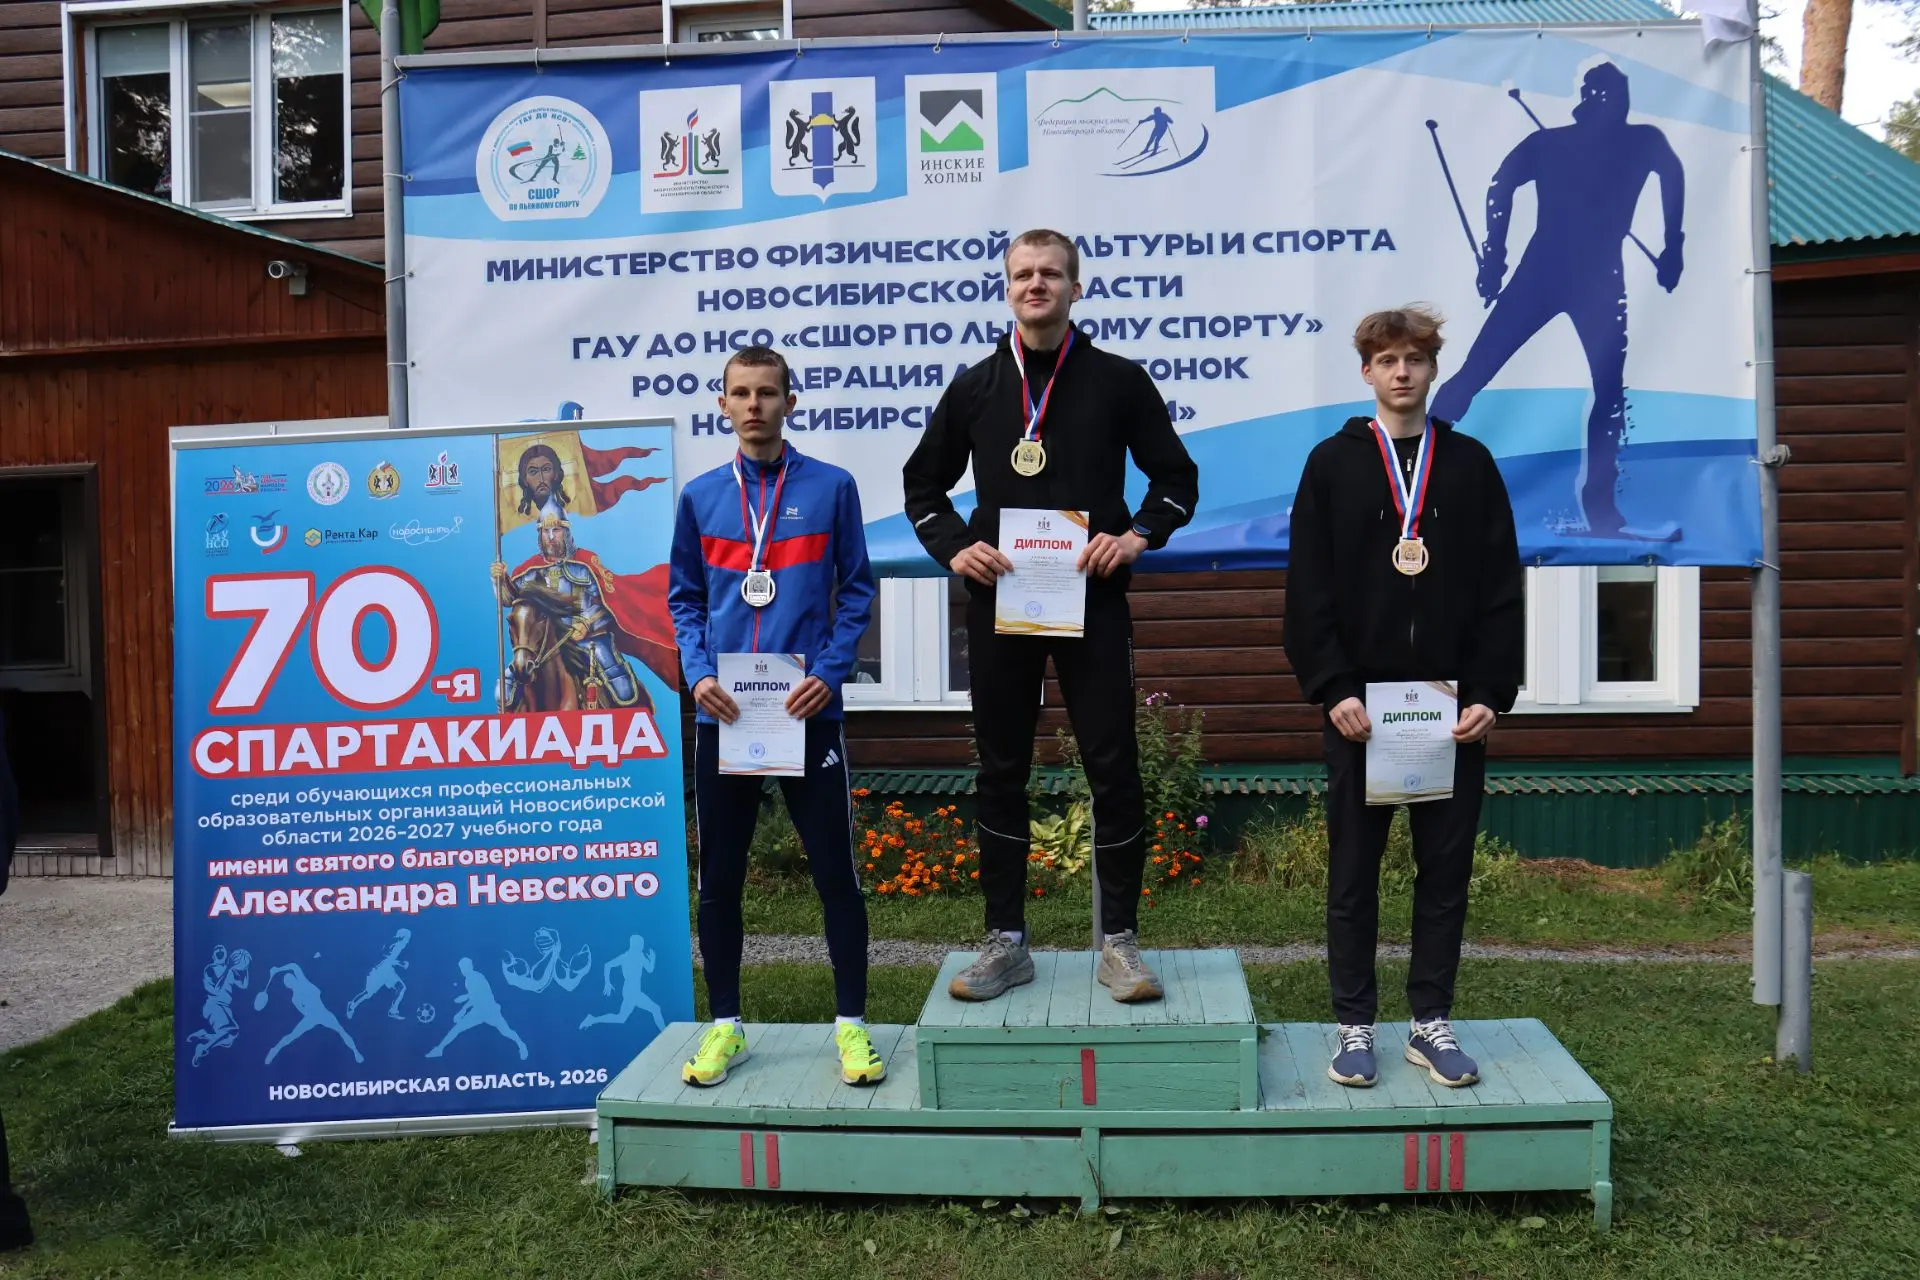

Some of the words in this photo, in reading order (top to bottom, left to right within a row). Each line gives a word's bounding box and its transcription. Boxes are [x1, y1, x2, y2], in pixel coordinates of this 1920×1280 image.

[920, 157, 985, 170] ИНСКИЕ
[924, 171, 982, 185] ХОЛМЫ
[528, 188, 560, 200] СШОР
[555, 200, 580, 208] СПОРТУ
[487, 247, 759, 282] МИНИСТЕРСТВО
[766, 230, 1010, 267] ФИЗИЧЕСКОЙ
[1073, 232, 1214, 258] ЛЬТУРЫ
[1221, 232, 1245, 255] И
[1252, 228, 1397, 254] СПОРТА
[697, 272, 1006, 312] НОВОСИБИРСКОЙ
[1080, 275, 1184, 300] АСТИ
[573, 334, 641, 359] ГАУ
[646, 332, 697, 358] ДО
[703, 328, 774, 353] НСО
[781, 324, 897, 348] «СШОР
[904, 322, 953, 345] ПО
[961, 317, 1153, 344] ЛЫОМУ
[1159, 313, 1324, 339] СПОРТУ»
[632, 373, 700, 398] РОО
[325, 529, 356, 540] Рента
[358, 528, 378, 541] Кар
[1013, 538, 1073, 550] ДИПЛОМ
[733, 681, 791, 694] ДИПЛОМ
[1382, 711, 1442, 724] ДИПЛОМ
[196, 711, 664, 775] СПАРТАКИАДА
[231, 791, 290, 808] среди
[296, 785, 432, 805] обучающихся
[438, 776, 632, 799] профессиональных
[198, 807, 373, 830] образовательных
[379, 800, 504, 822] организаций
[510, 791, 666, 814] Новосибирской
[262, 829, 342, 846] области
[461, 822, 552, 840] учебного
[559, 818, 603, 834] года
[208, 859, 289, 877] имени
[295, 853, 395, 873] святого
[401, 845, 579, 868] благоверного
[584, 841, 659, 859] князя
[208, 880, 458, 918] Александра
[468, 872, 660, 905] Невского
[269, 1077, 450, 1101] НОВОСИБИРСКАЯ
[456, 1072, 555, 1091] ОБЛАСТЬ,
[560, 1068, 608, 1085] 2026
